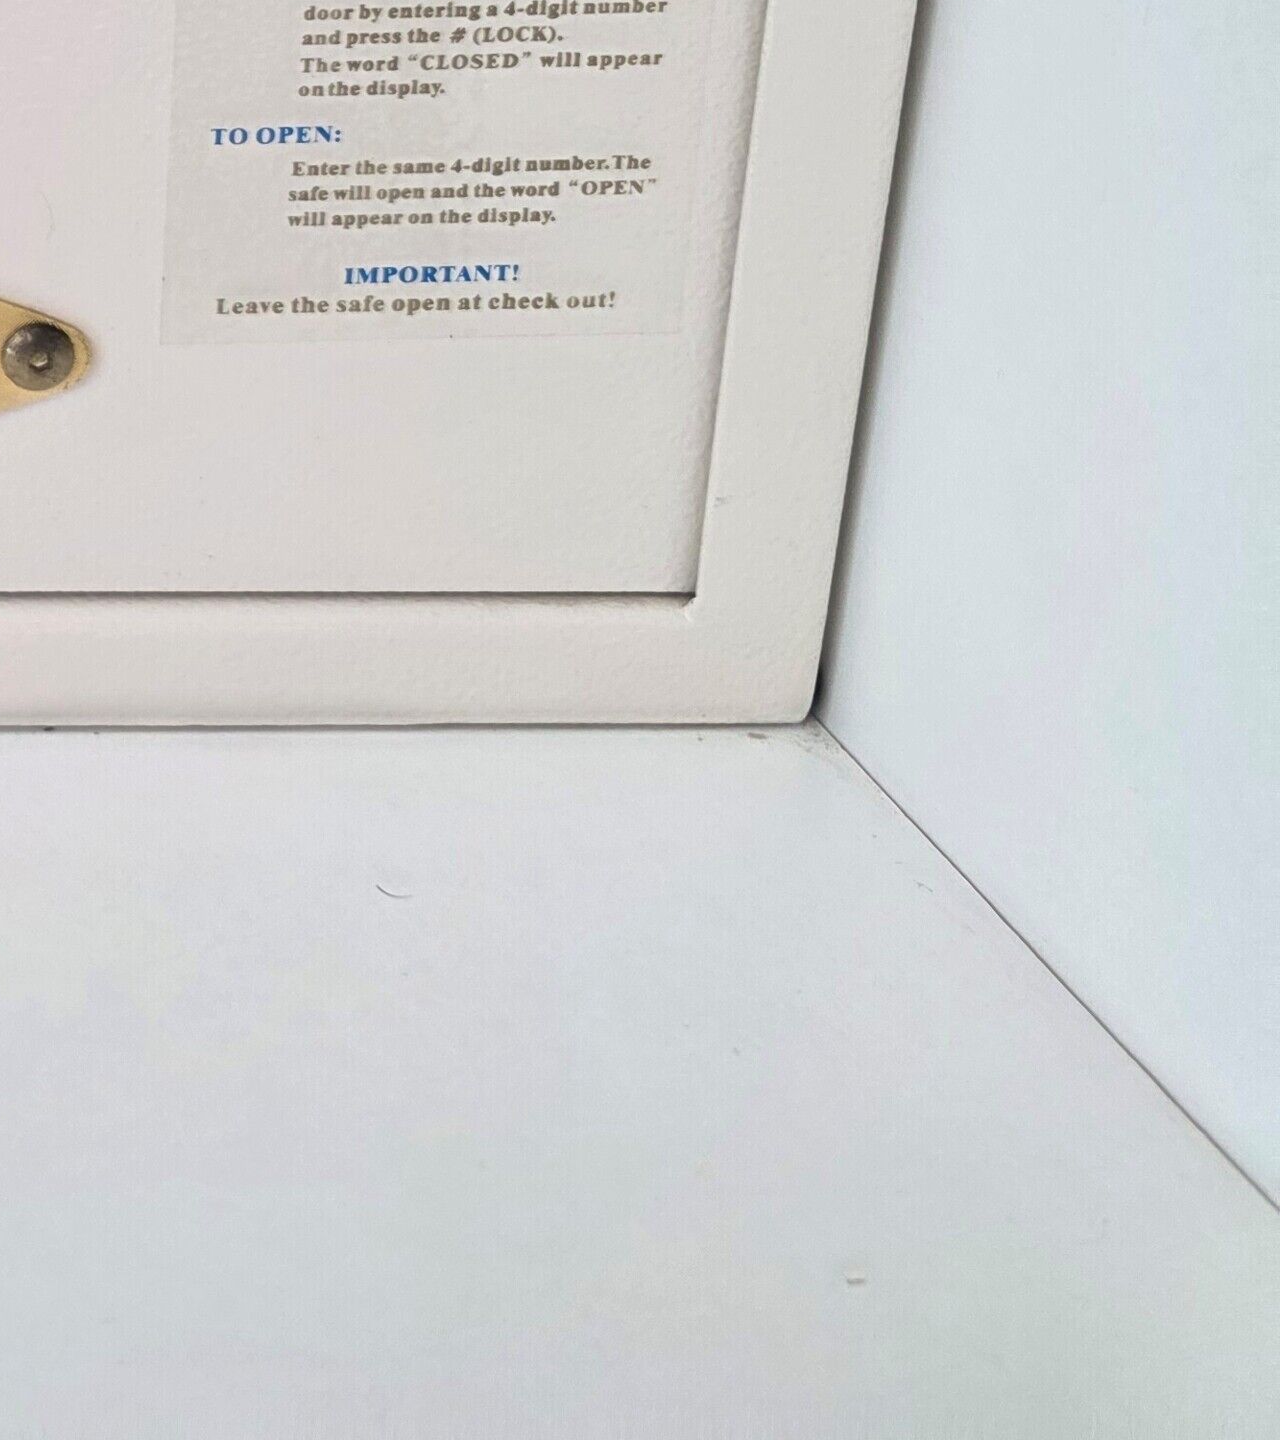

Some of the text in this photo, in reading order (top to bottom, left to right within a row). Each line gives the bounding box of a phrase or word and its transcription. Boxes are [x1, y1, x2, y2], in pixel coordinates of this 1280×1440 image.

[304, 5, 355, 21] door
[358, 4, 383, 22] by
[387, 1, 481, 21] entering
[486, 4, 498, 17] a
[302, 25, 564, 49] and press the # (LOCK).
[300, 57, 341, 73] The
[346, 55, 399, 72] word
[539, 51, 581, 68] will
[586, 53, 663, 70] appear
[366, 79, 445, 99] display.
[210, 125, 341, 146] TO OPEN:
[291, 161, 352, 177] Enter
[355, 160, 388, 175] the
[392, 161, 446, 175] same
[450, 157, 521, 176] 4-digit
[288, 186, 329, 202] safe
[333, 185, 371, 200] will
[376, 186, 425, 203] open
[430, 184, 469, 199] and
[473, 183, 506, 198] the
[511, 181, 560, 197] word
[287, 207, 556, 230] will appear on the display.
[344, 264, 520, 285] IMPORTANT!
[216, 291, 616, 316] Leave the safe open at check out!
